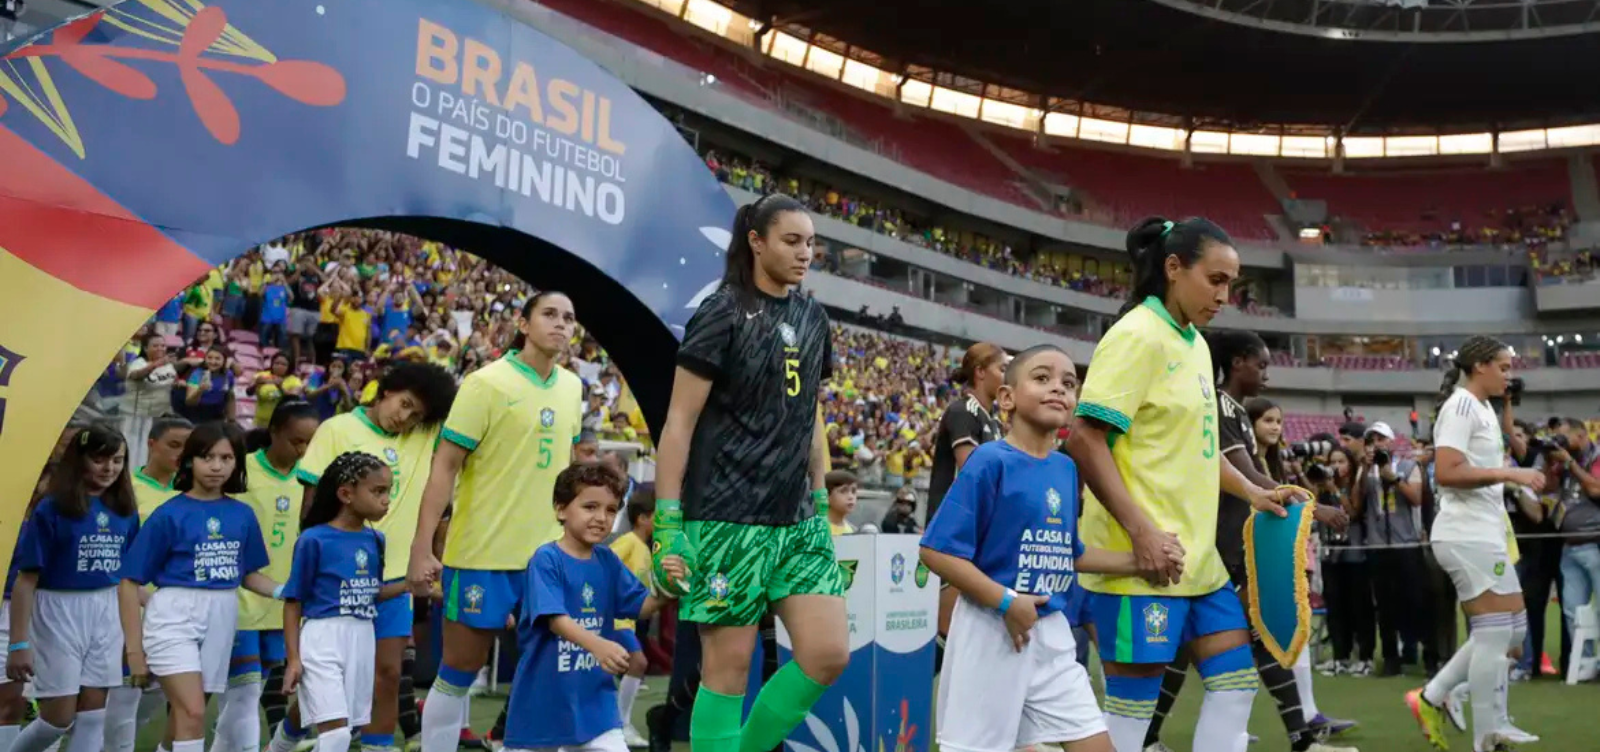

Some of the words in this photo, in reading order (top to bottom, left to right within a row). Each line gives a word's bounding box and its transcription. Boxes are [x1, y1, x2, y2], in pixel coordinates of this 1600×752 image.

[415, 17, 625, 155] BRASIL
[412, 82, 431, 108] O
[438, 92, 489, 130] PAÍS
[496, 113, 526, 144] DO
[533, 129, 626, 182] FUTEBOL
[406, 111, 625, 225] FEMININO
[785, 359, 800, 397] 5
[1202, 414, 1214, 459] 5
[536, 438, 553, 469] 5
[79, 534, 88, 544] A
[89, 534, 113, 544] CASA
[201, 541, 227, 551] CASA
[270, 522, 286, 548] 5
[1021, 528, 1033, 541] A
[1035, 529, 1063, 543] CASA
[1064, 532, 1072, 544] D
[1015, 569, 1031, 591] É
[1033, 573, 1073, 596] AQUI
[885, 618, 928, 631] BRASILEIRA
[558, 652, 571, 672] É
[573, 652, 600, 672] AQ
